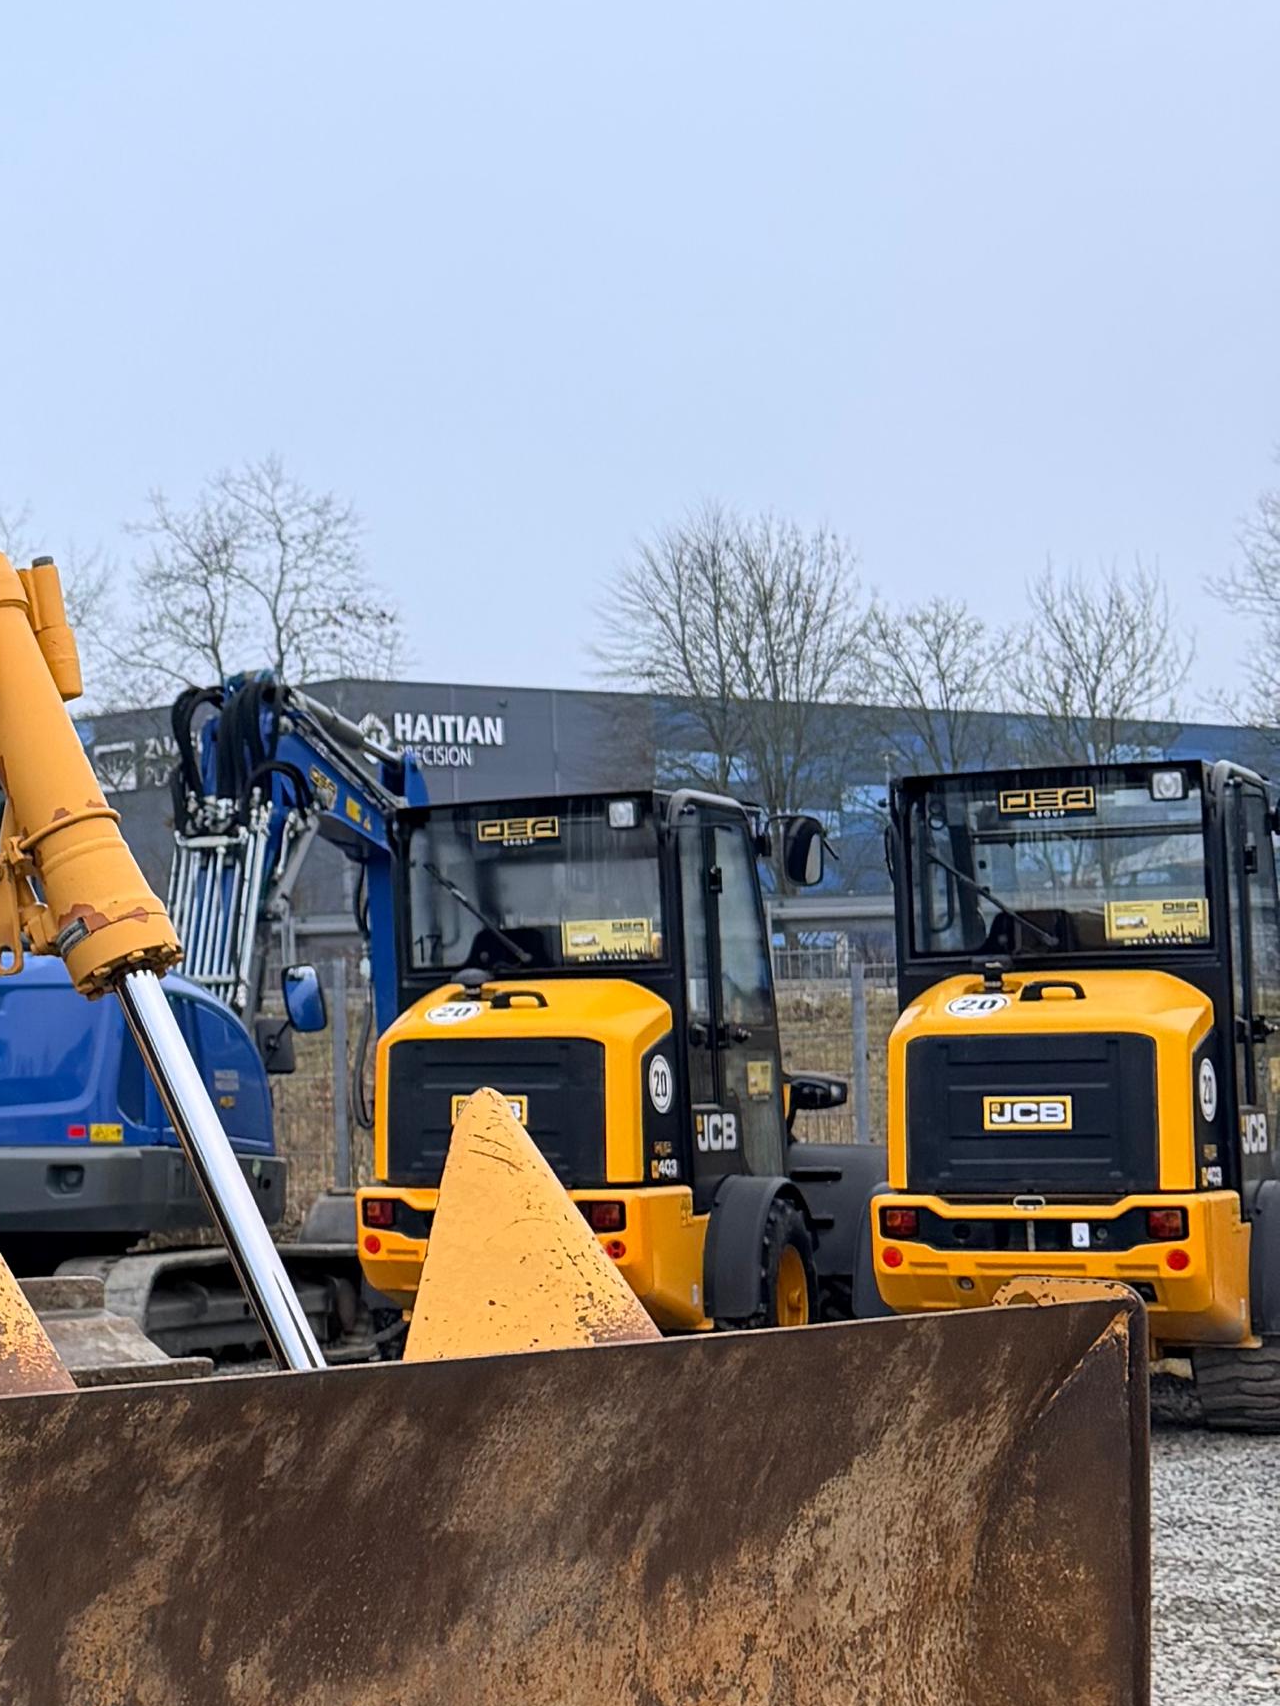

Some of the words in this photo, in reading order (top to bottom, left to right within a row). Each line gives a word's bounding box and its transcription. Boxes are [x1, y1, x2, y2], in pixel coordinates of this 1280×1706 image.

[393, 712, 503, 745] HAITIAN
[957, 999, 998, 1010] 20
[653, 1070, 668, 1097] 20
[991, 1102, 1065, 1123] JCB
[696, 1113, 737, 1152] JCB
[1241, 1113, 1268, 1155] JCB
